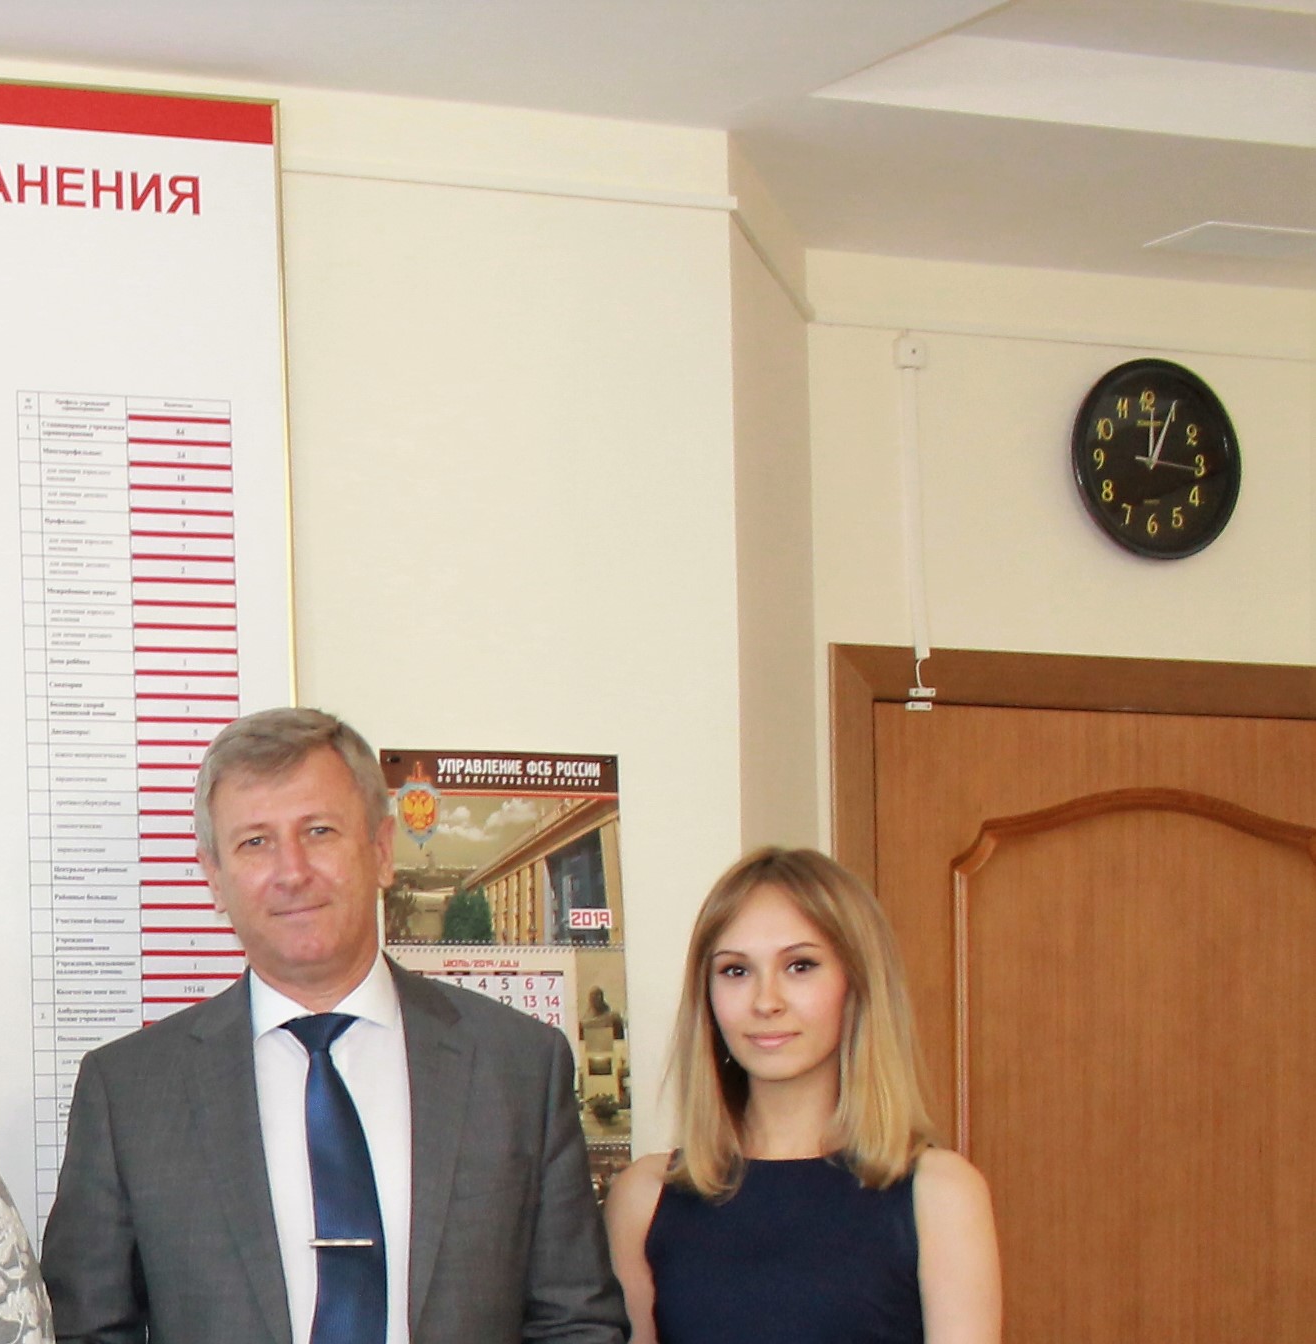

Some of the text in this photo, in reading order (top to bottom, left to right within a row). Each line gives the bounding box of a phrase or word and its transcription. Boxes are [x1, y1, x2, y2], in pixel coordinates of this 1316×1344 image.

[1116, 397, 1129, 419] 11
[1139, 390, 1156, 411] 12
[1096, 418, 1113, 440] 10
[1186, 424, 1198, 445] 2
[1093, 448, 1105, 470] 9
[1194, 454, 1205, 477] 3
[1101, 479, 1114, 502] 8
[1189, 485, 1200, 507] 4
[1121, 503, 1132, 526] 7
[1146, 513, 1158, 535] 6
[1172, 506, 1183, 528] 5
[437, 758, 601, 779] УПРАВЛЕНИЕ ФСБ РОССИИ
[456, 774, 551, 786] Волгоградской
[553, 777, 600, 787] области
[570, 911, 611, 927] 2019
[478, 978, 487, 990] 4
[501, 978, 510, 990] 5
[525, 978, 534, 990] 6
[547, 978, 556, 990] 7
[498, 995, 560, 1008] 12 13 14
[546, 1013, 560, 1025] 21
